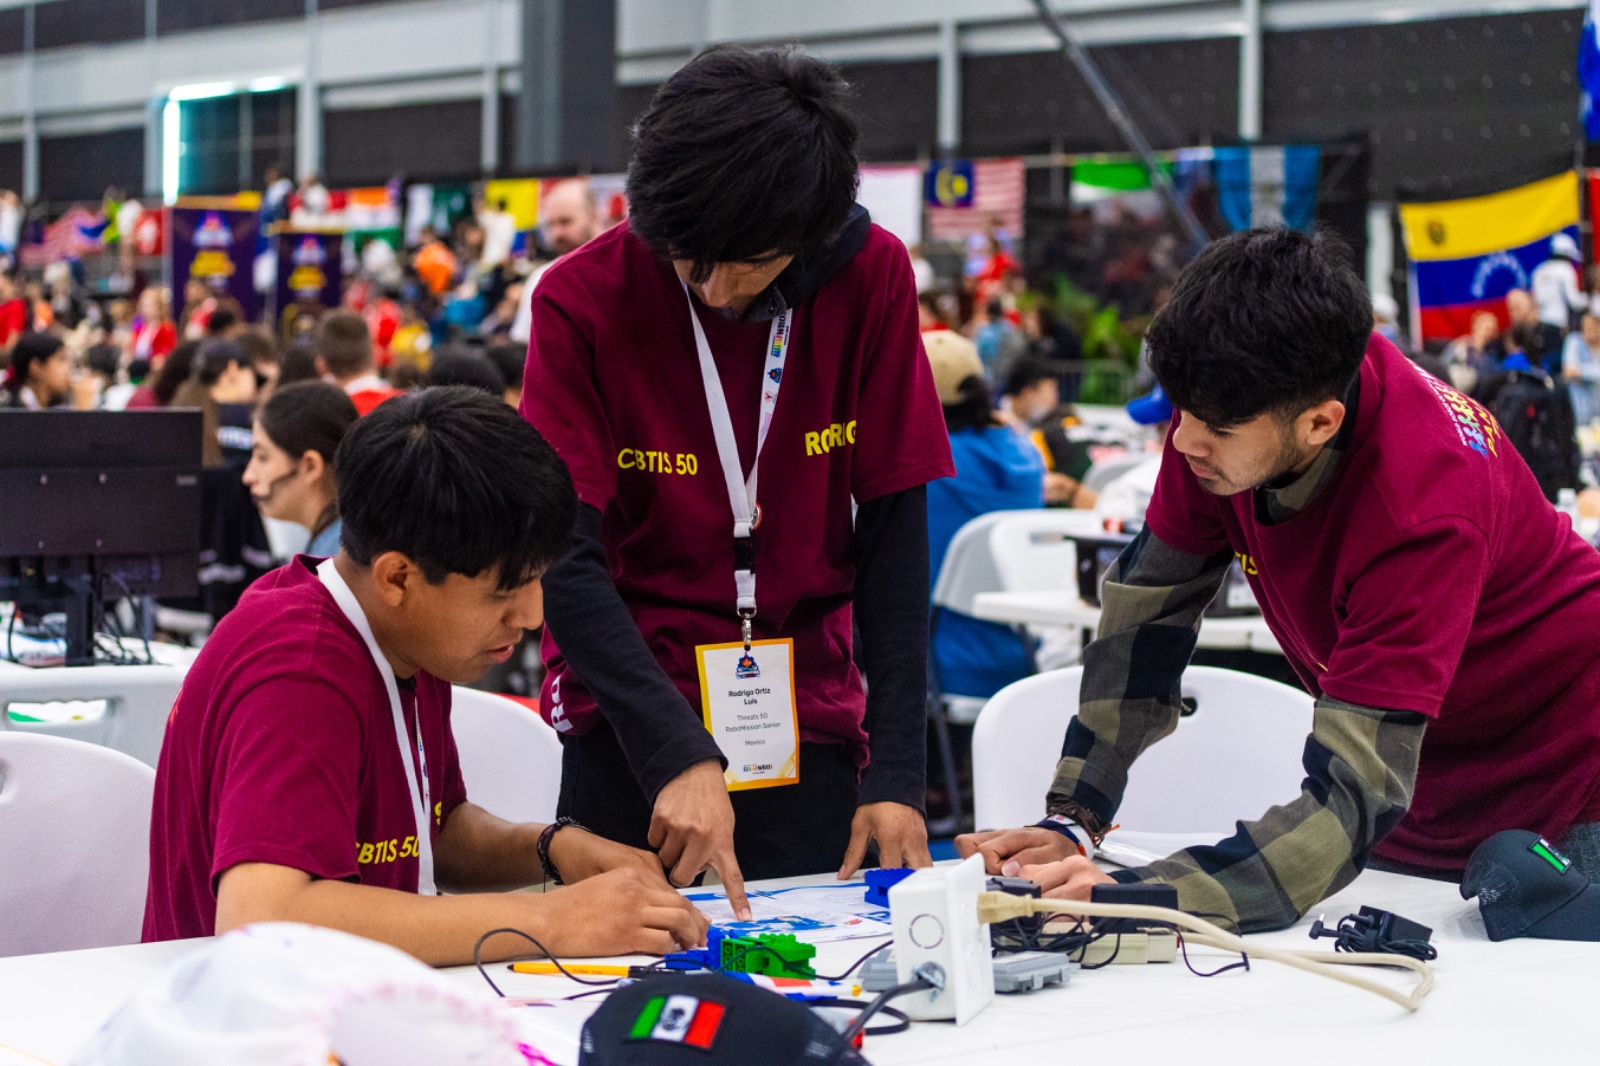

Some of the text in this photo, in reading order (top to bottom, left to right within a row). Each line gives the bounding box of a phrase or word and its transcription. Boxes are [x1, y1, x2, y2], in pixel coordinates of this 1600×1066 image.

[617, 447, 698, 476] CBTIS 50
[728, 687, 771, 697] Rodrigo Ortiz
[760, 712, 768, 720] 50
[725, 724, 761, 732] RoboMission
[745, 739, 766, 747] Mexico
[356, 838, 398, 865] BTIS
